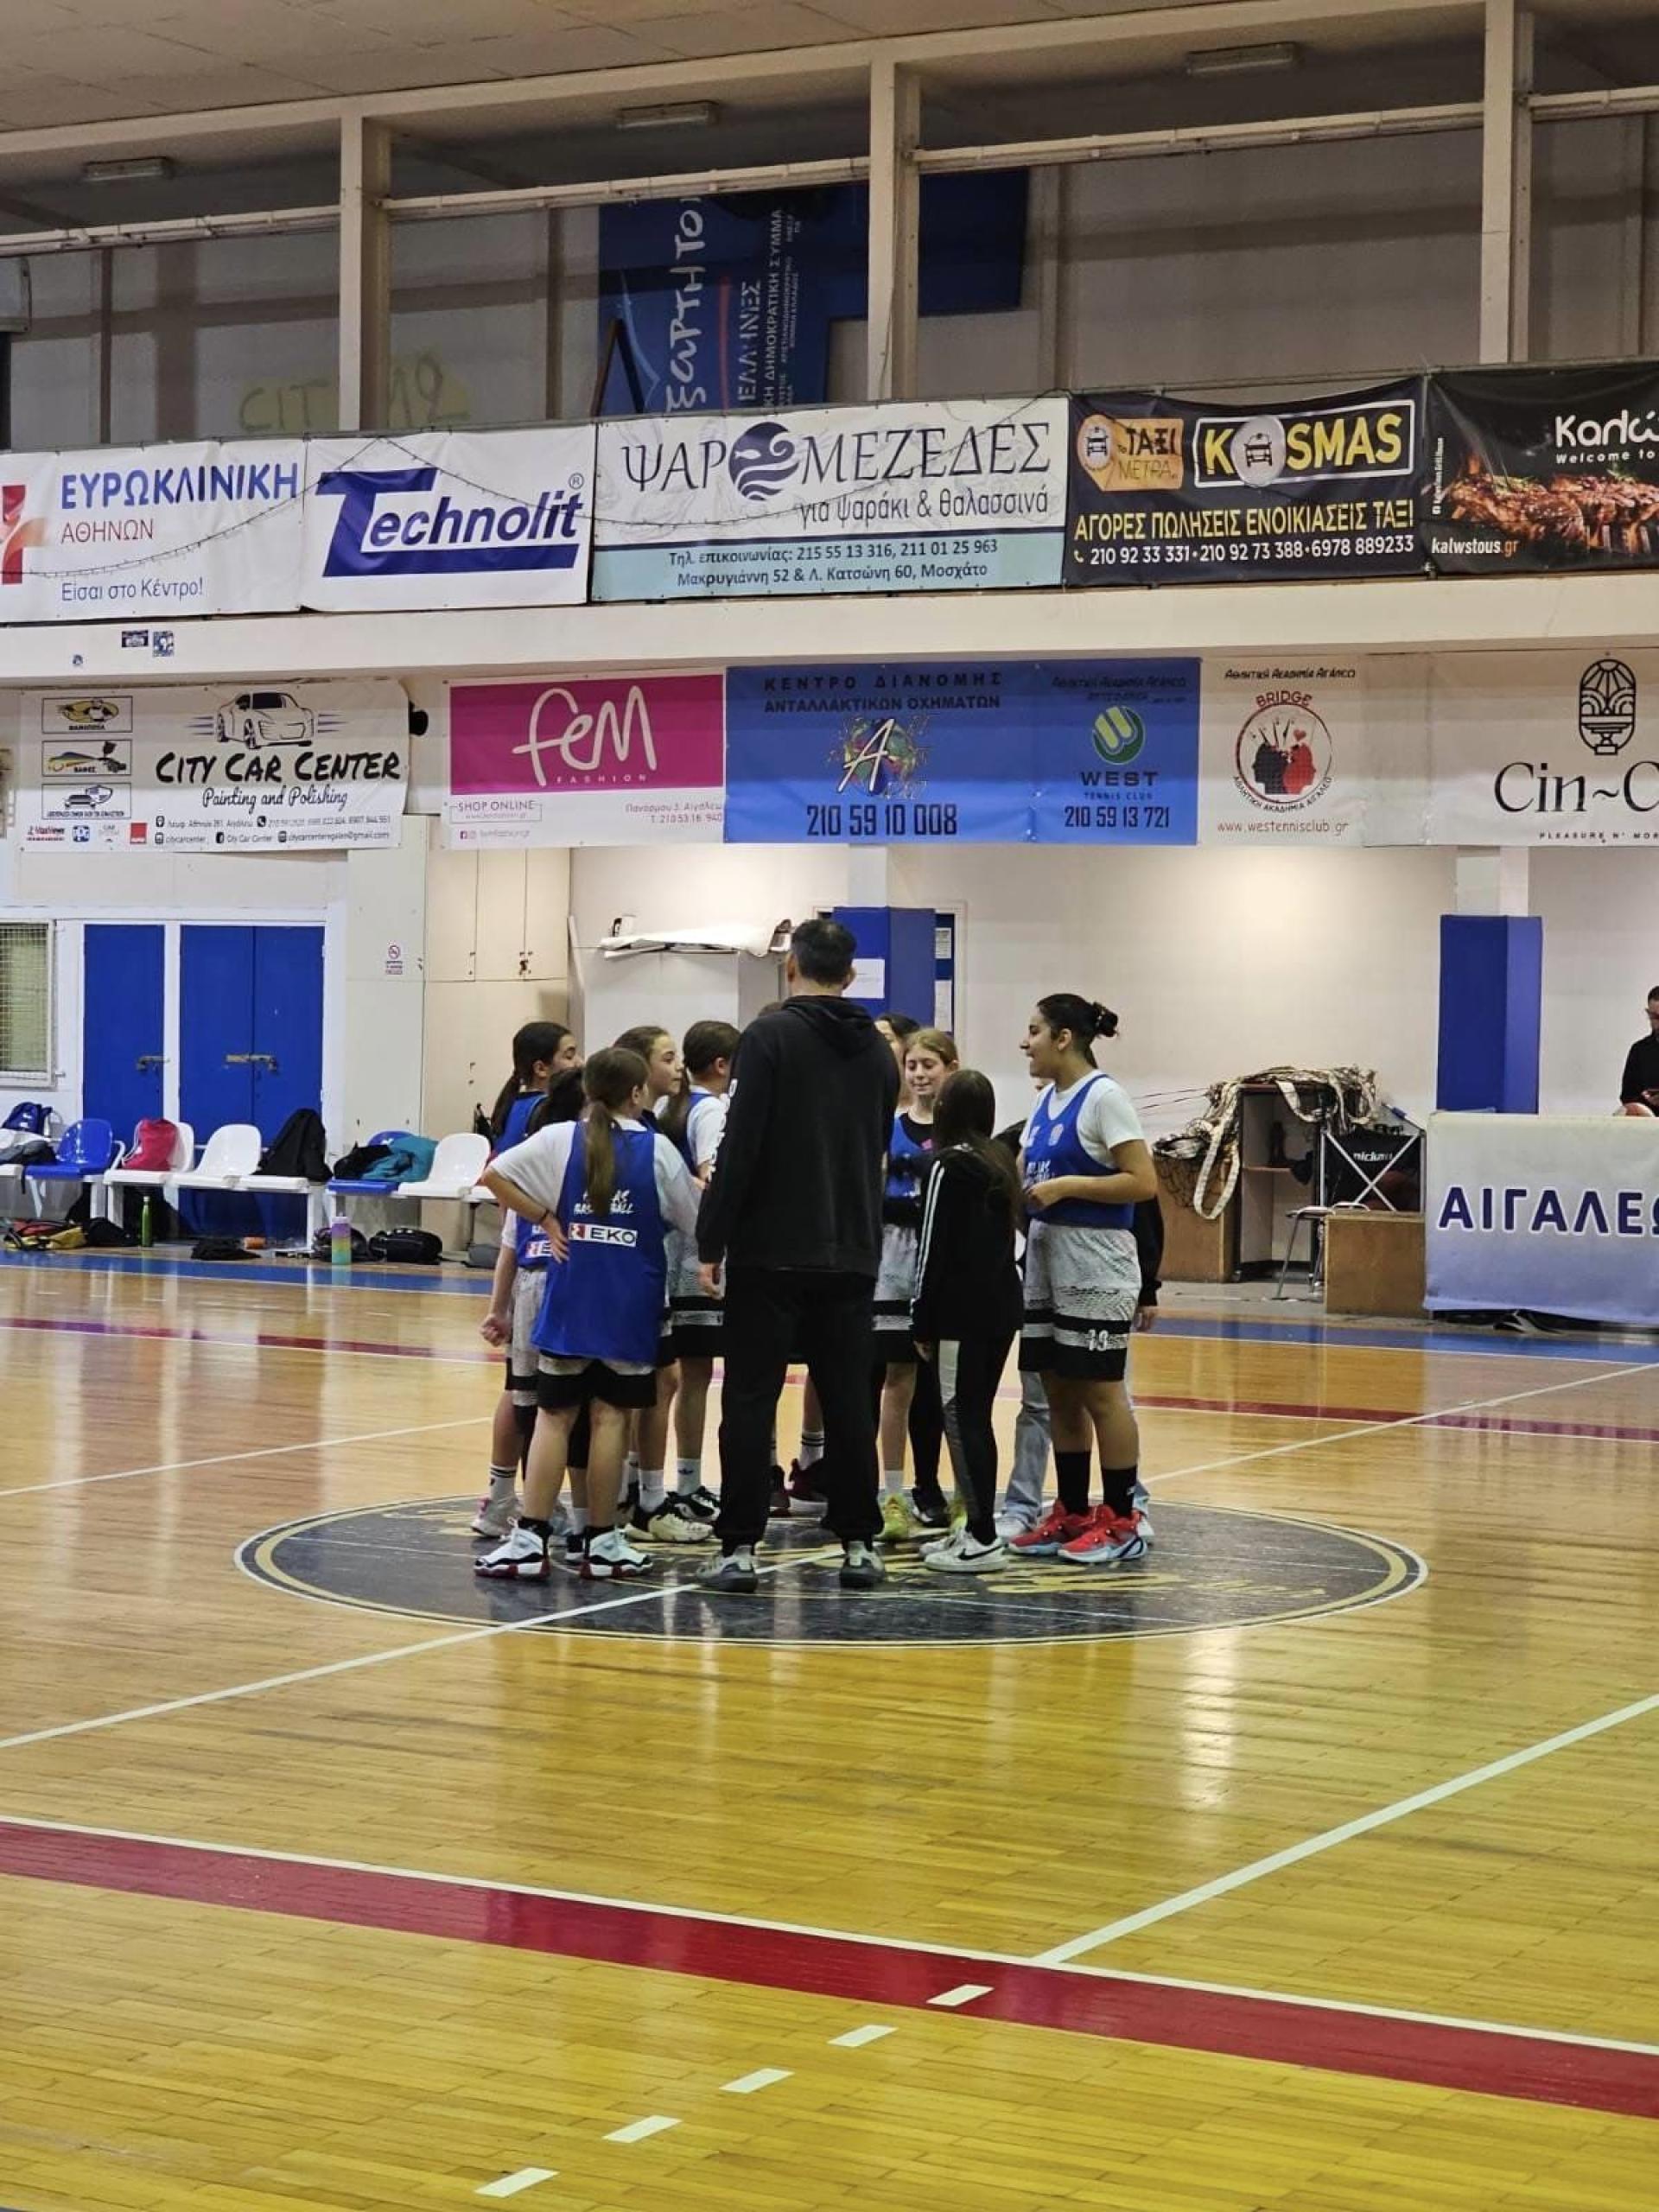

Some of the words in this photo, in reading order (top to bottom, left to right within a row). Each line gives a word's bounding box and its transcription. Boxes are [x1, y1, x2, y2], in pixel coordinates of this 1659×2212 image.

[765, 272, 779, 380] ΔΗΜΟΚΡΑΤΙΚΗ
[1126, 427, 1177, 455] ΤΑΞΙ
[1555, 451, 1630, 465] Welcome
[1638, 448, 1656, 460] to
[61, 462, 299, 510] ΕΥΡΩΚΛΙΝΙΚΗ
[799, 503, 830, 530] για
[918, 494, 931, 517] &
[939, 485, 1049, 517] θαλασσινά
[60, 518, 154, 543] ΑΘΗΝΩΝ
[1073, 512, 1147, 542] ΑΓΟΡΕΣ
[1152, 509, 1242, 540] ΠΩΛΗΣΕΙΣ
[1246, 502, 1368, 536] ΕΝΟΙΚΙΑΣΕΙΣ
[1372, 499, 1414, 529] ΤΑΞΙ
[698, 545, 793, 563] επικοινωνίας:
[797, 546, 822, 561] 215
[824, 545, 842, 559] 55
[846, 544, 863, 558] 13
[868, 543, 897, 560] 316,
[900, 541, 926, 556] 211
[931, 541, 948, 556] 01
[953, 539, 969, 554] 25
[974, 538, 998, 554] 963
[1090, 547, 1116, 565] 210
[1120, 547, 1139, 563] 92
[1142, 546, 1160, 563] 33
[1230, 543, 1249, 561] 92
[1252, 543, 1271, 560] 73
[1354, 534, 1414, 555] 889233
[1431, 537, 1520, 558] kalwstous.gr
[677, 569, 769, 588] Μακρυγιάννη
[772, 569, 789, 583] 52
[794, 567, 804, 582] &
[809, 567, 823, 582] Λ.
[827, 564, 891, 582] Κατσώνη
[894, 564, 917, 580] 60,
[921, 561, 988, 579] Μοσχάτο
[61, 582, 103, 601] Είσαι
[108, 583, 137, 600] στο
[141, 576, 204, 602] Κέντρο!
[764, 676, 857, 692] ΚΕΝΤΡΟ
[874, 671, 1001, 689] ΔΙΑΝΟΜΗΣ
[764, 697, 903, 714] ΑΝΤΑΛΛΑΚΤΙΚΩΝ
[906, 695, 1001, 711] ΟΧΗΜΑΤΩΝ
[1255, 690, 1313, 708] BRIDGE
[156, 751, 218, 785] CITY
[224, 752, 283, 784] CAR
[294, 751, 401, 782] CENTER
[556, 773, 647, 785] FASHION
[1080, 771, 1159, 787] WEST
[202, 786, 257, 815] Painting
[261, 785, 284, 806] and
[288, 785, 348, 812] Polishing
[458, 801, 487, 811] SHOP
[490, 799, 535, 810] ONLINE
[1084, 792, 1122, 802] TENNIS
[806, 804, 842, 836] 210
[849, 804, 878, 836] 59
[885, 804, 906, 835] 10
[913, 803, 957, 835] 008
[1064, 805, 1090, 829] 210
[1096, 805, 1116, 829] 59
[1123, 805, 1139, 829] 13
[1143, 805, 1170, 829] 721
[1438, 1186, 1659, 1235] ΑΙΓΑΛΕ
[591, 1227, 635, 1244] EKO
